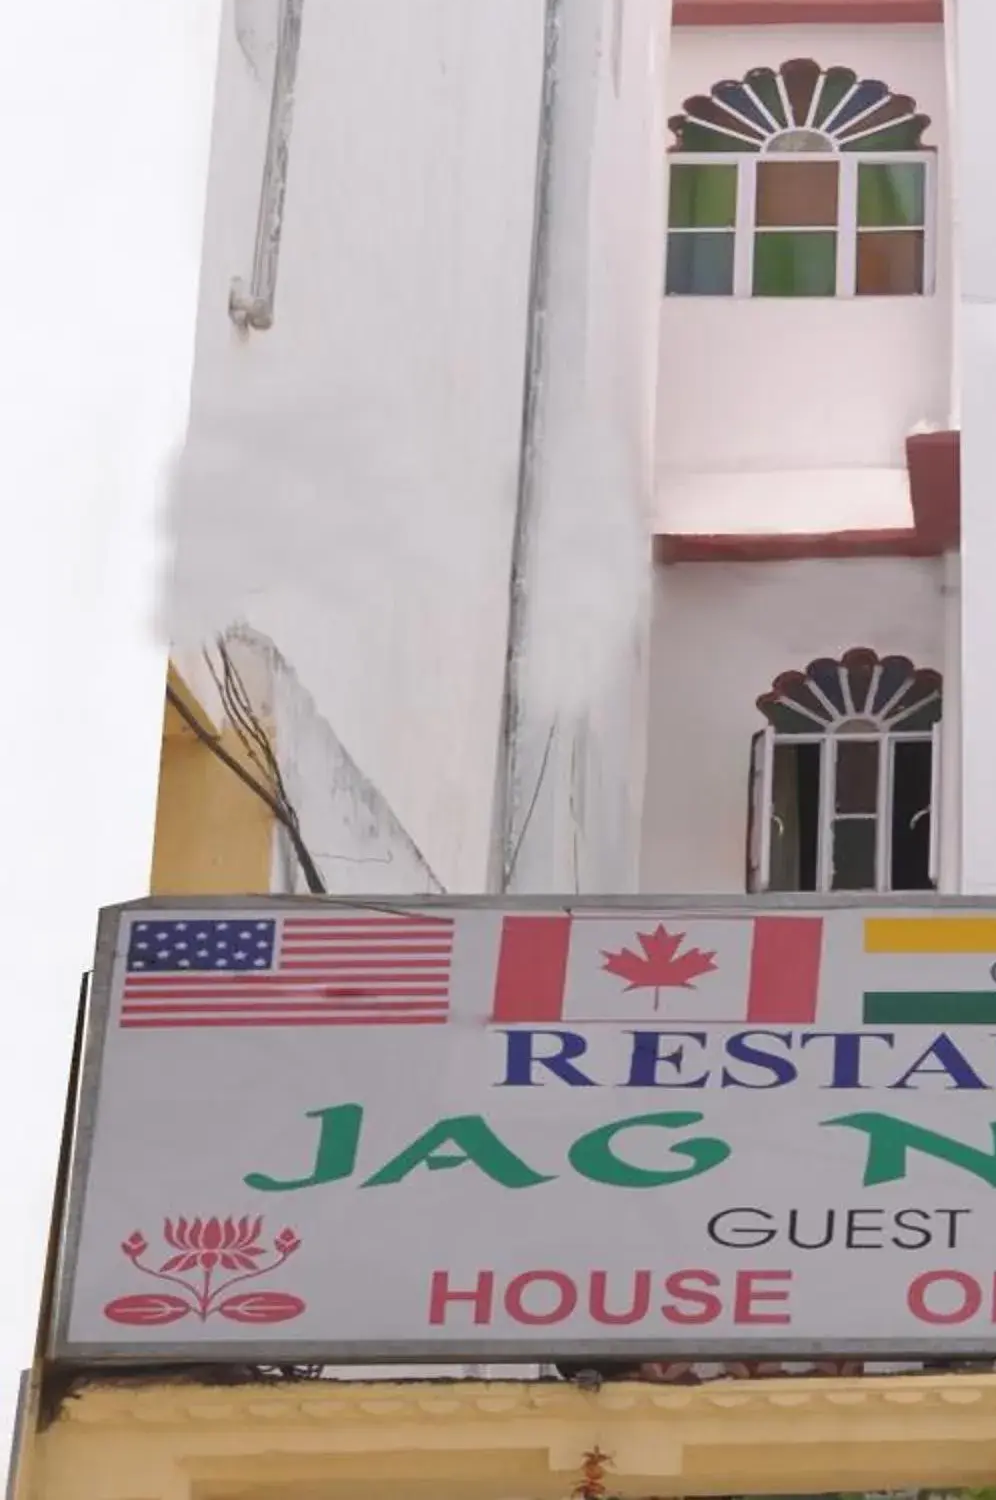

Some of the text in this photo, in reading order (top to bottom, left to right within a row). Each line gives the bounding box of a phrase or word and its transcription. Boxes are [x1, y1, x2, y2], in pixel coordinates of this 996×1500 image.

[243, 1104, 731, 1192] JAG
[706, 1208, 972, 1250] GUEST
[428, 1270, 793, 1326] HOUSE
